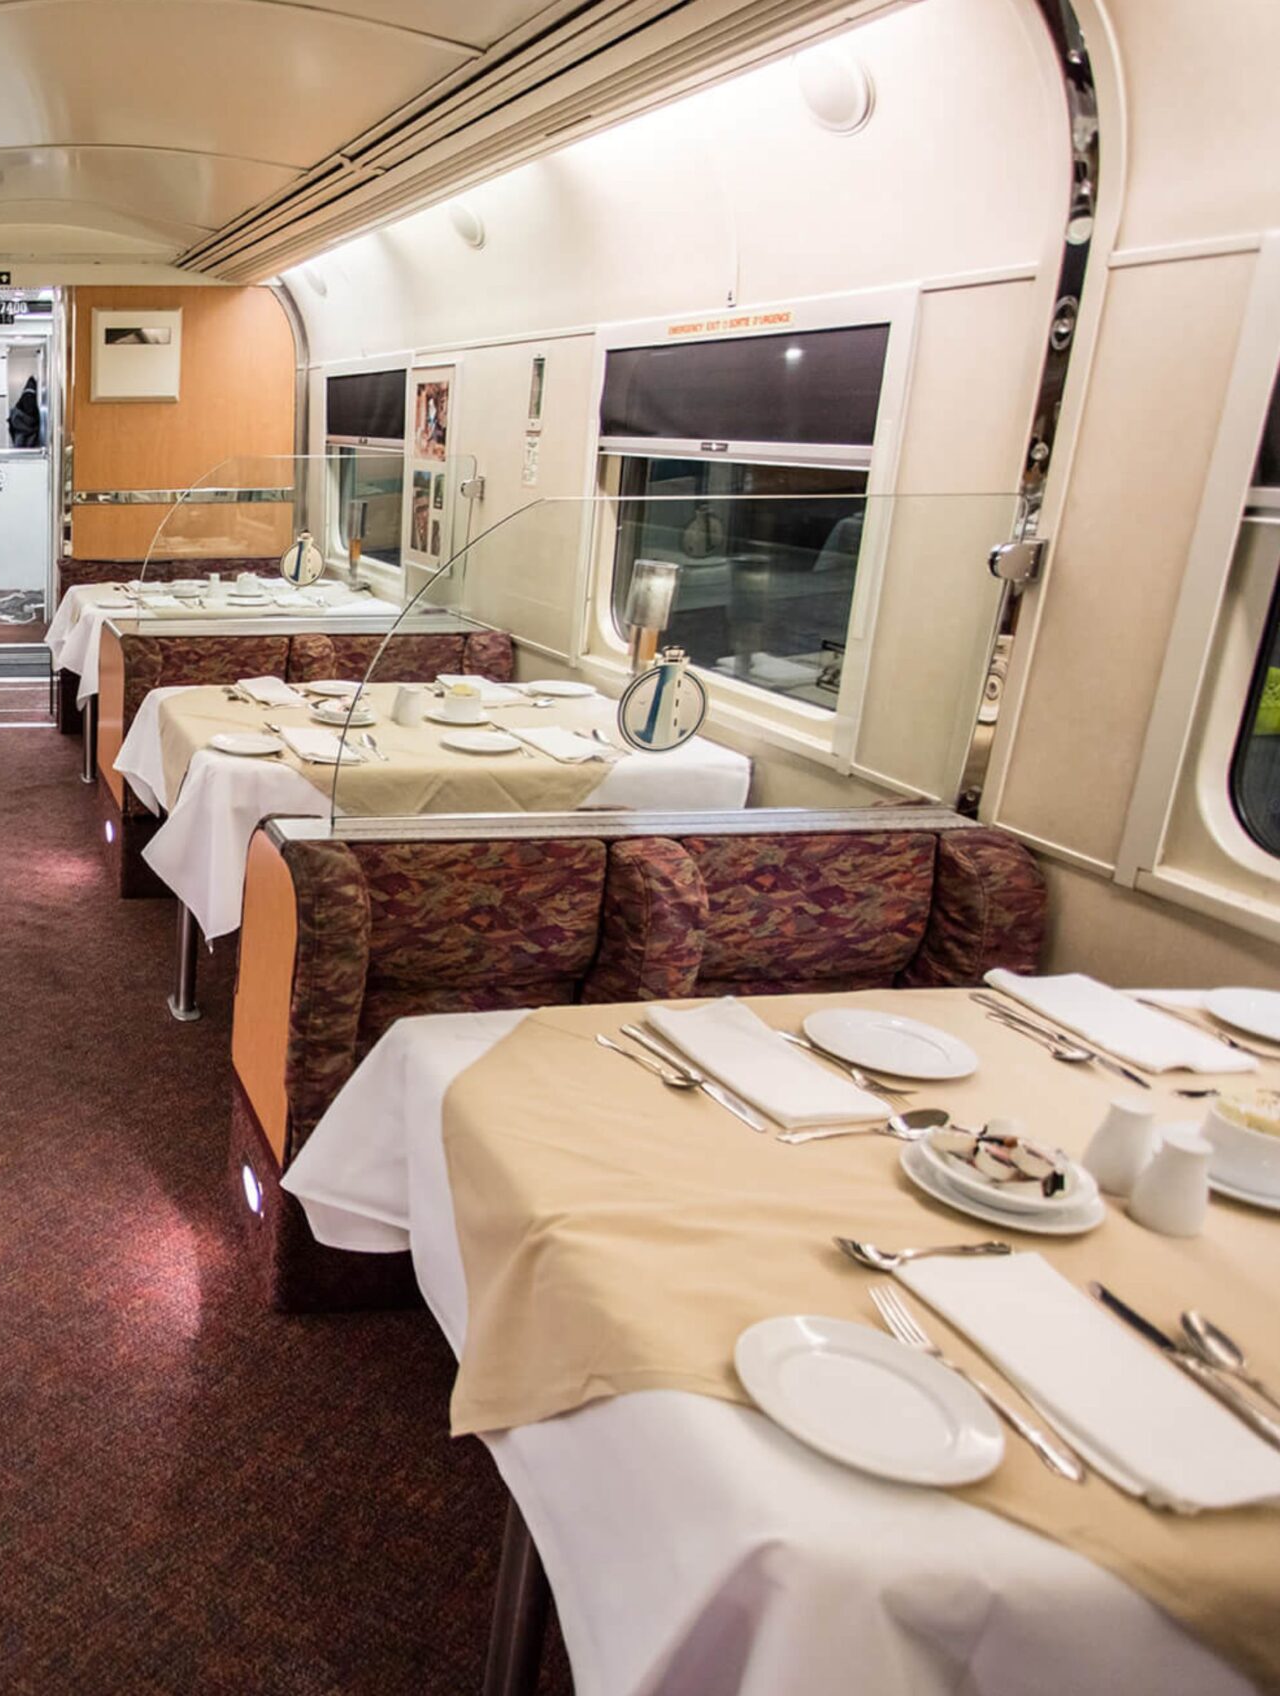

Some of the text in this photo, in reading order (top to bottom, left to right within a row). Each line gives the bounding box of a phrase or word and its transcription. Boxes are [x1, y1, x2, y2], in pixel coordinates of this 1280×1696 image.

[0, 302, 29, 315] 7400
[668, 323, 703, 335] EMERGENCY
[706, 320, 720, 331] EXIT
